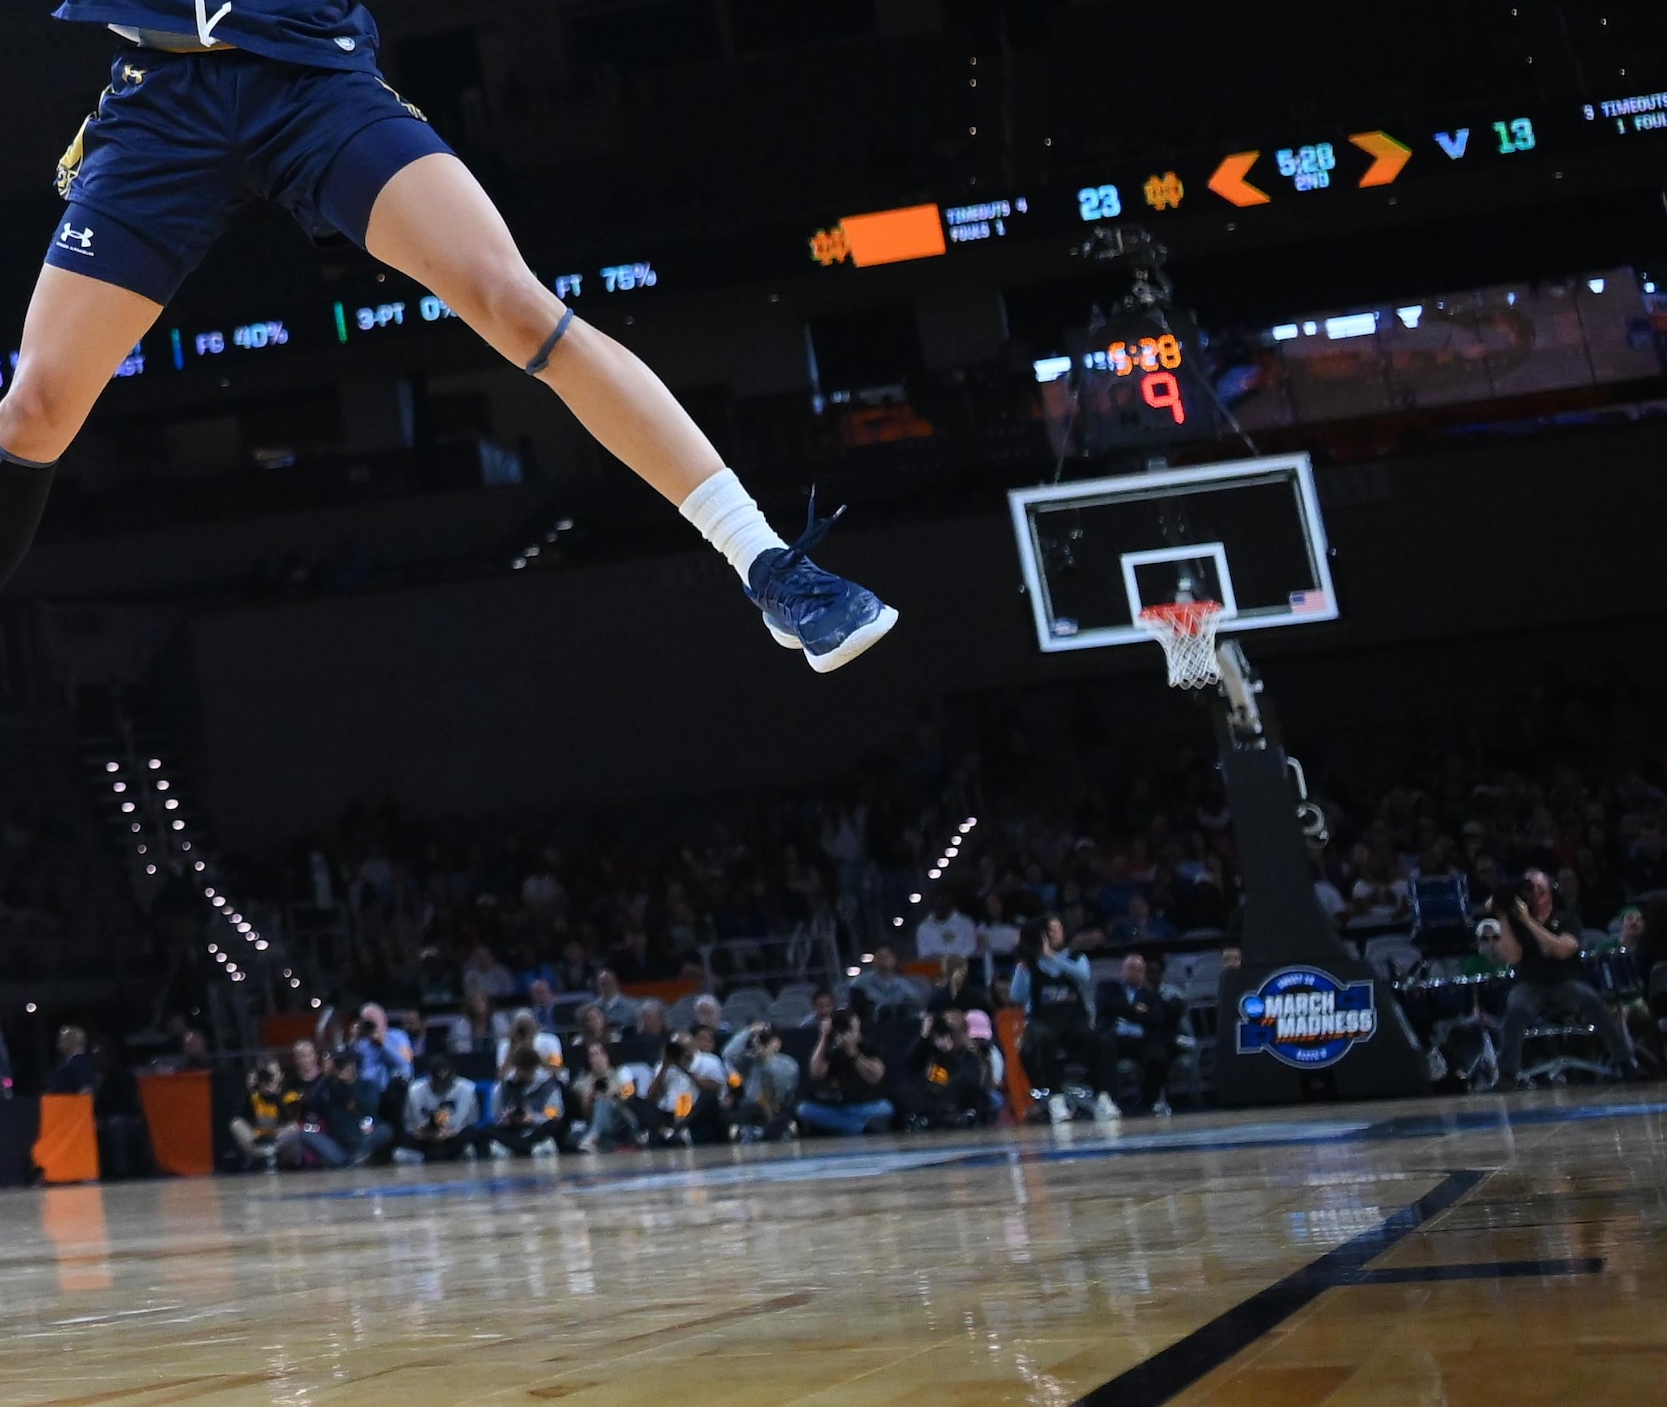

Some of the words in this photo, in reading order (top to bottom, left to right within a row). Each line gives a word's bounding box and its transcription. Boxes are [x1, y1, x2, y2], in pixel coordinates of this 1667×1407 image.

[1493, 117, 1536, 155] 13
[1275, 142, 1336, 178] 5:28
[1077, 184, 1122, 222] 23
[555, 274, 583, 300] FT
[1141, 371, 1186, 425] 9
[1264, 990, 1335, 1018] MARCH
[1277, 1009, 1373, 1038] MADNESS
